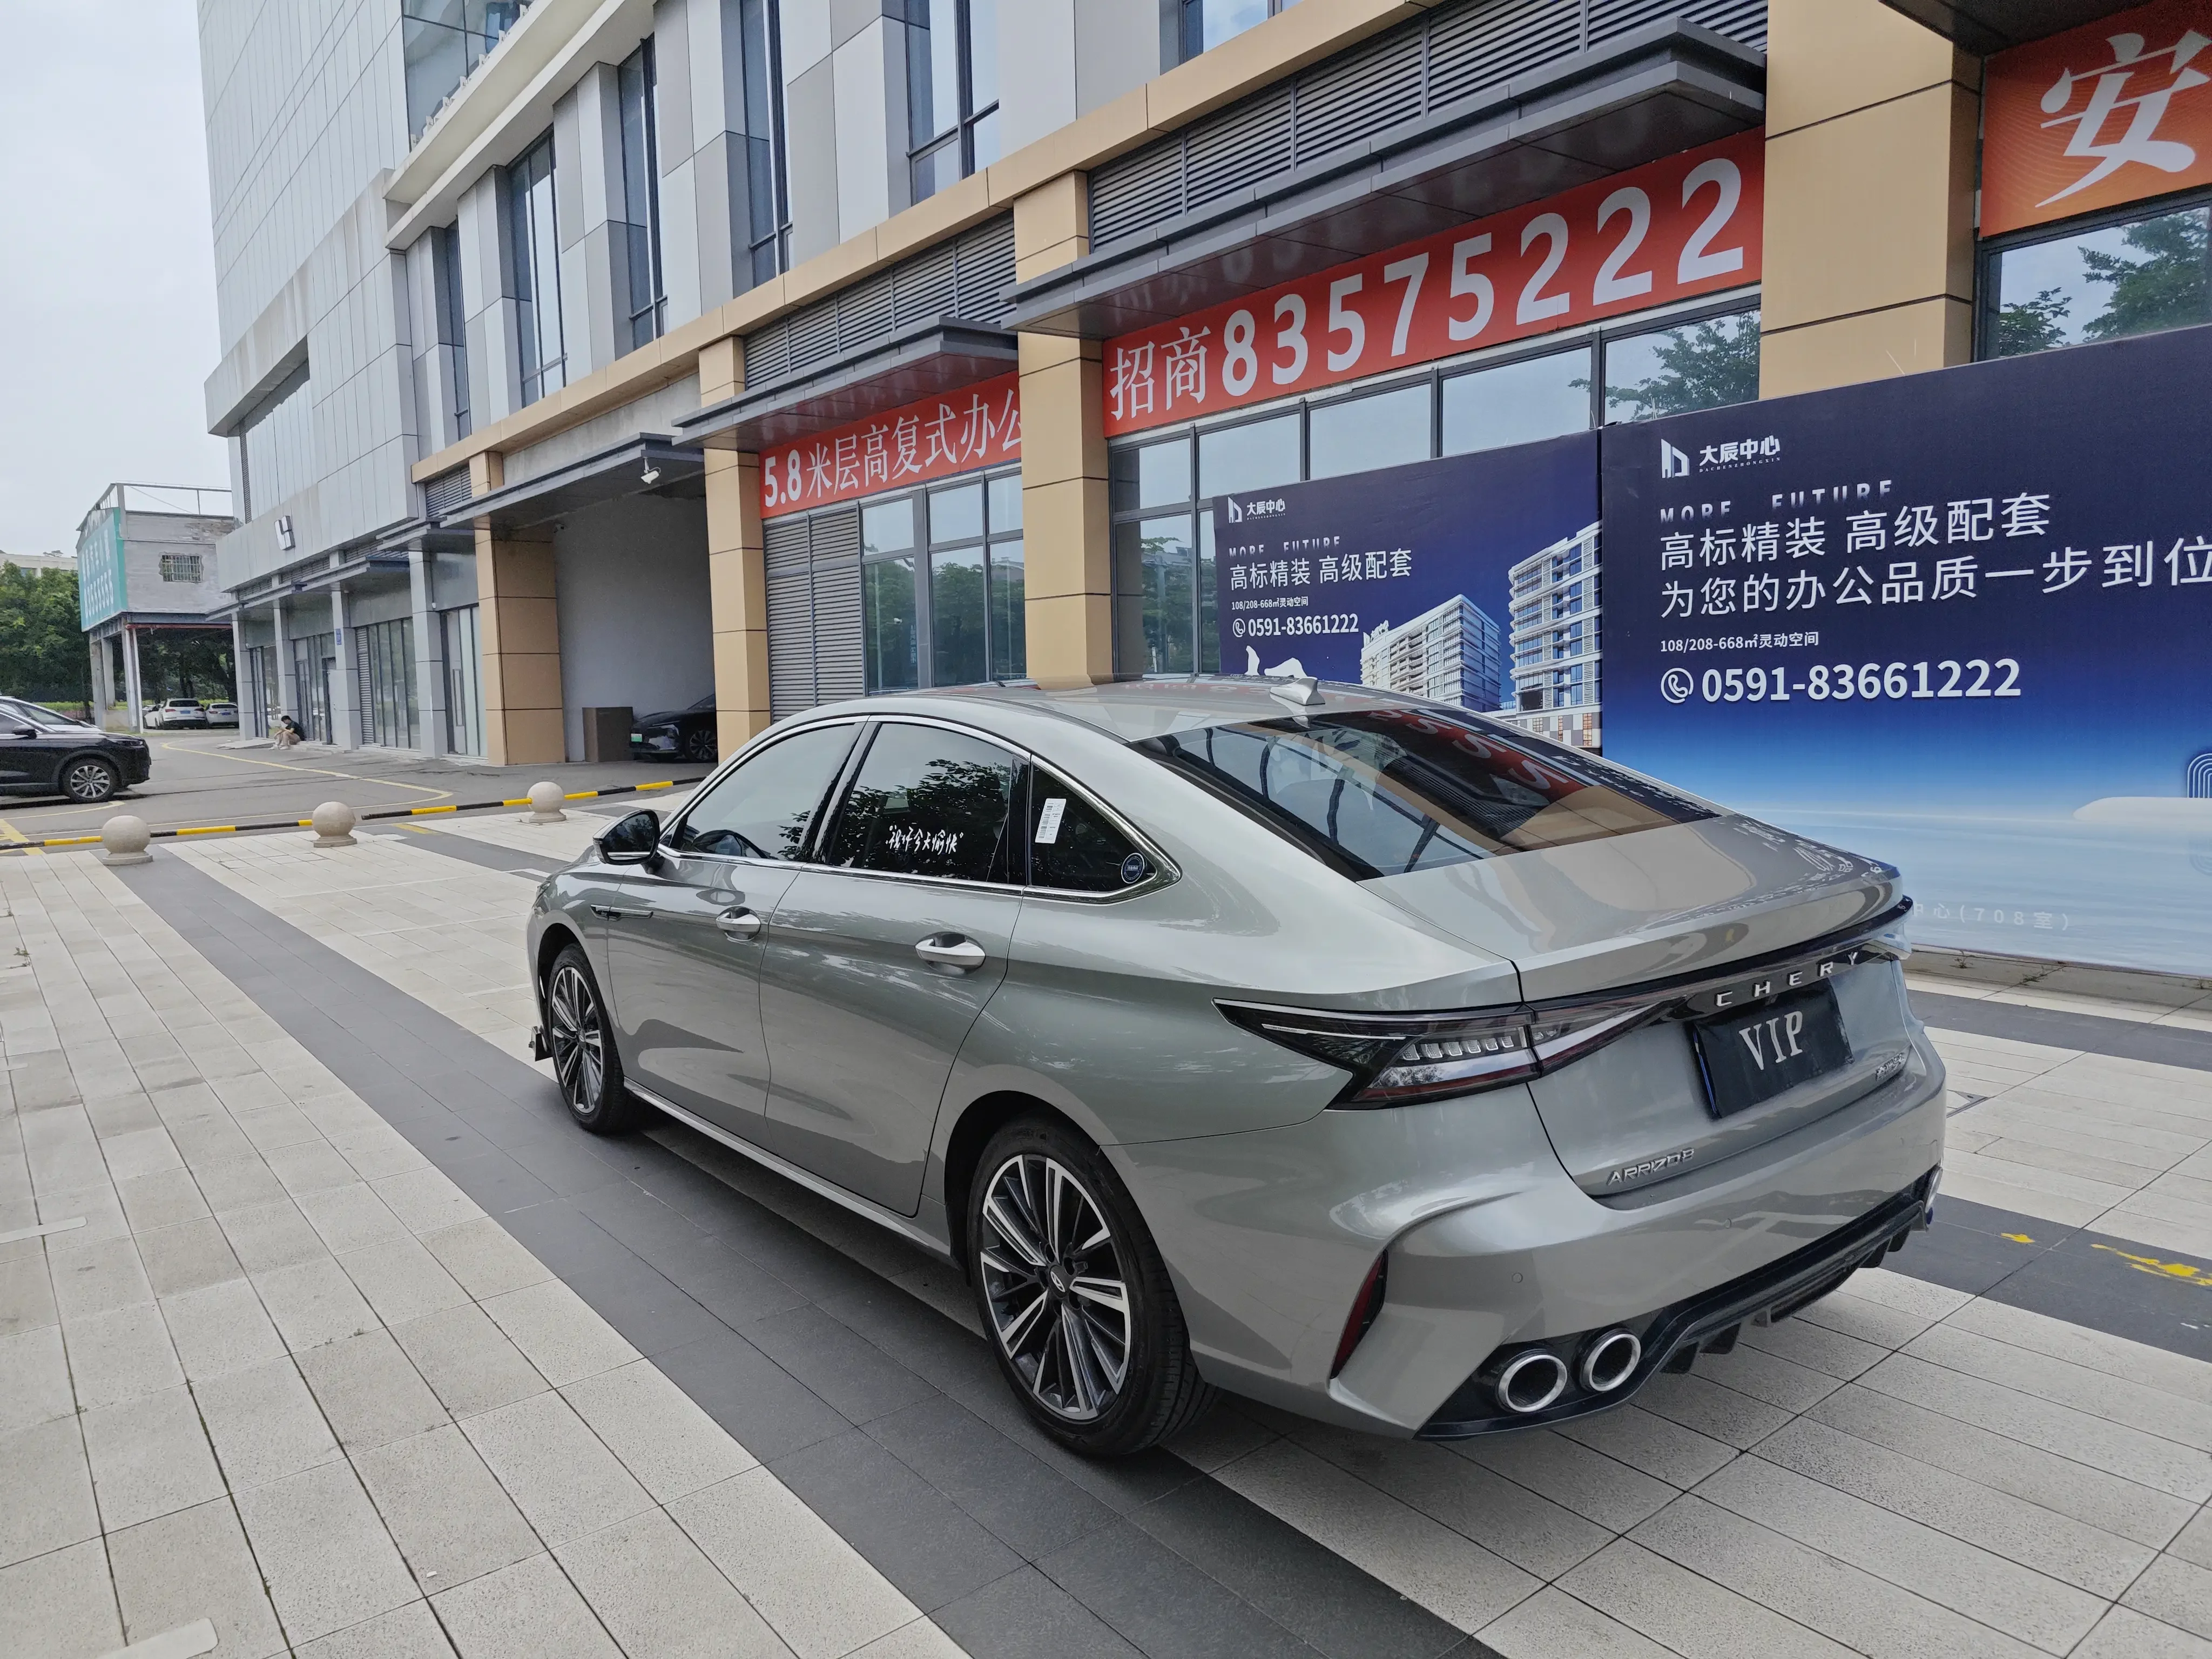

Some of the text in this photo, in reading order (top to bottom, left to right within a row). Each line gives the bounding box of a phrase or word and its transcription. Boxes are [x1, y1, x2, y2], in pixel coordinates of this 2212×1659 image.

[2034, 30, 2212, 208] 安
[1110, 158, 1744, 421] 招商83575222
[764, 388, 1021, 508] 5.8米层高复式办公
[1699, 435, 1781, 467] 大辰中心
[1699, 457, 1781, 473] DACHENZHONGXIN
[1246, 498, 1286, 516] 大辰中心
[1660, 480, 1892, 524] MORE FUTURE
[1229, 536, 1340, 558] MORE FUTURE
[1660, 492, 2051, 571] 高标精装 高级配套
[1230, 548, 1413, 591] 高标精装 高级配套
[1660, 535, 2212, 618] 为您的办公品质一步到位
[1247, 613, 1359, 637] 0591-83661222
[1702, 658, 2022, 703] 0591-83661222
[1716, 946, 1858, 1007] CHERY
[1738, 1010, 1803, 1070] VIP
